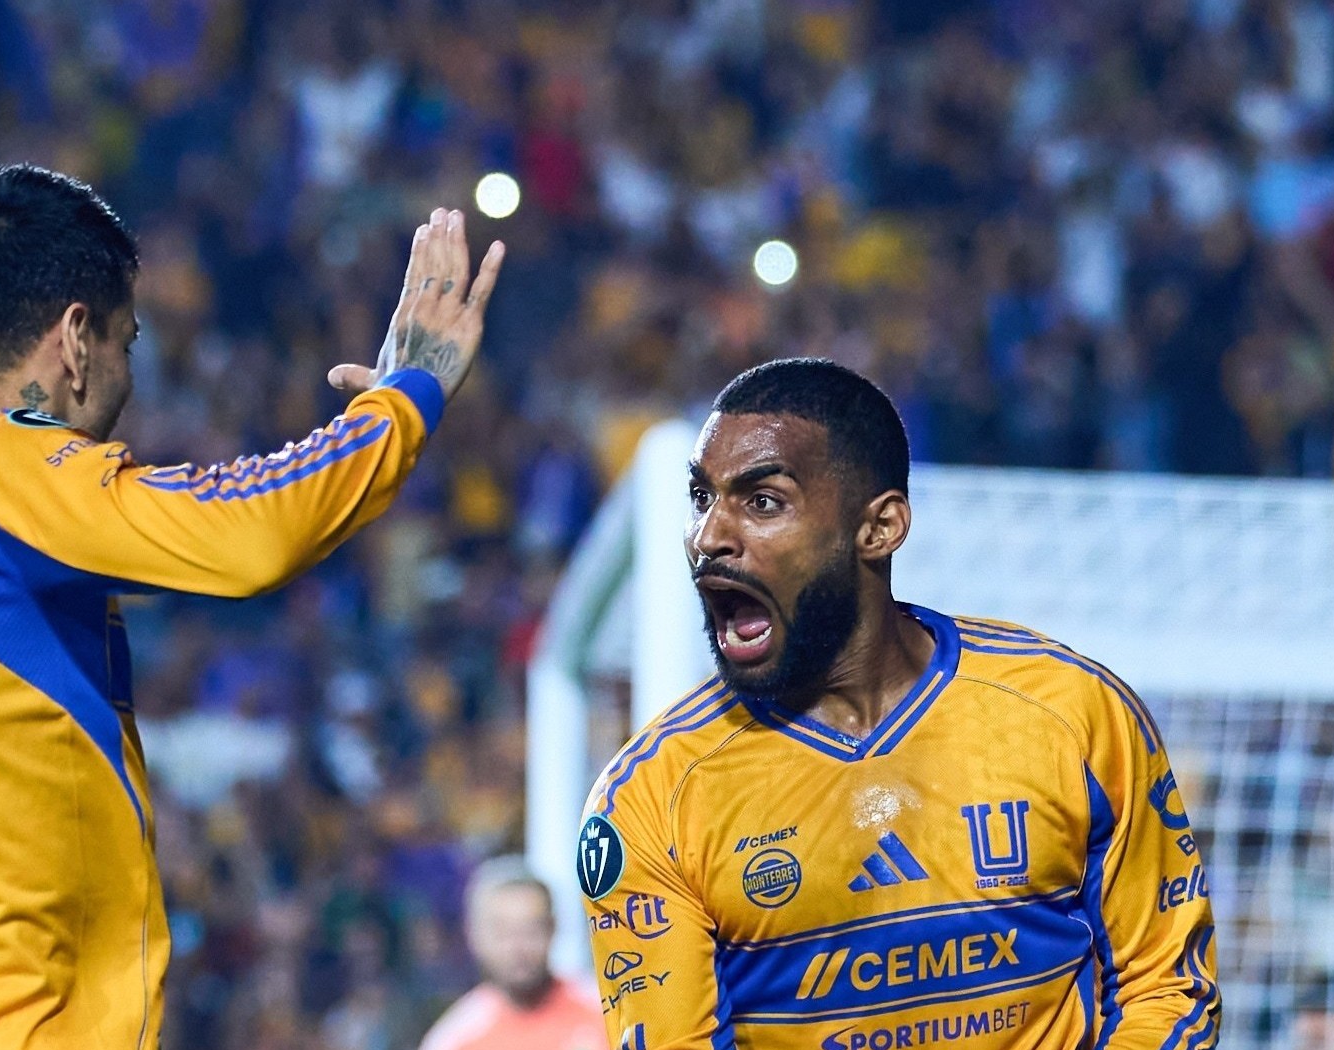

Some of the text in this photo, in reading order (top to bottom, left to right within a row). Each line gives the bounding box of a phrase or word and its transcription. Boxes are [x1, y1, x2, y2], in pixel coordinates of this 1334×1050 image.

[750, 826, 798, 848] CEMEX
[961, 800, 1030, 877] U
[744, 865, 799, 893] MONTERREY
[626, 894, 669, 931] fit
[851, 928, 1020, 991] CEMEX
